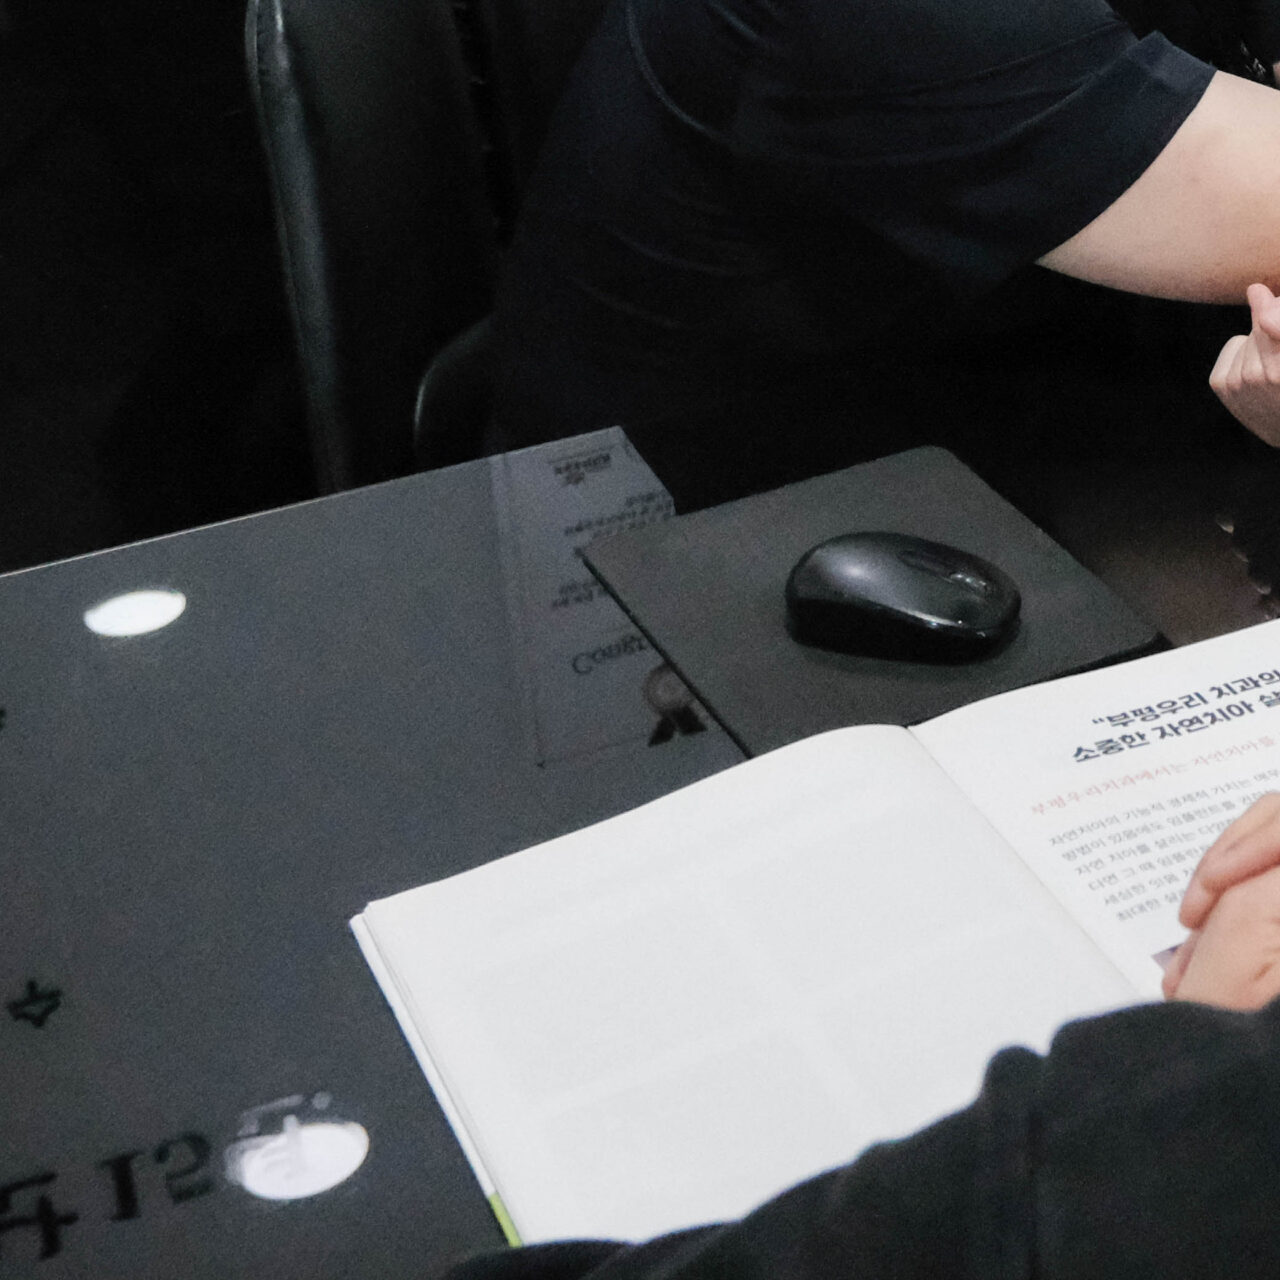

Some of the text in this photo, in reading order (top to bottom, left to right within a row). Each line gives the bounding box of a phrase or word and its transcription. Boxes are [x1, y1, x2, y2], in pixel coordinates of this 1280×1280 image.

[1073, 731, 1150, 763] 소중한
[1151, 701, 1255, 740] 자연치아
[1031, 761, 1189, 815] 부평우리치과에서는
[1193, 736, 1275, 766] 자연치아를
[1049, 814, 1120, 847] 자연치아의
